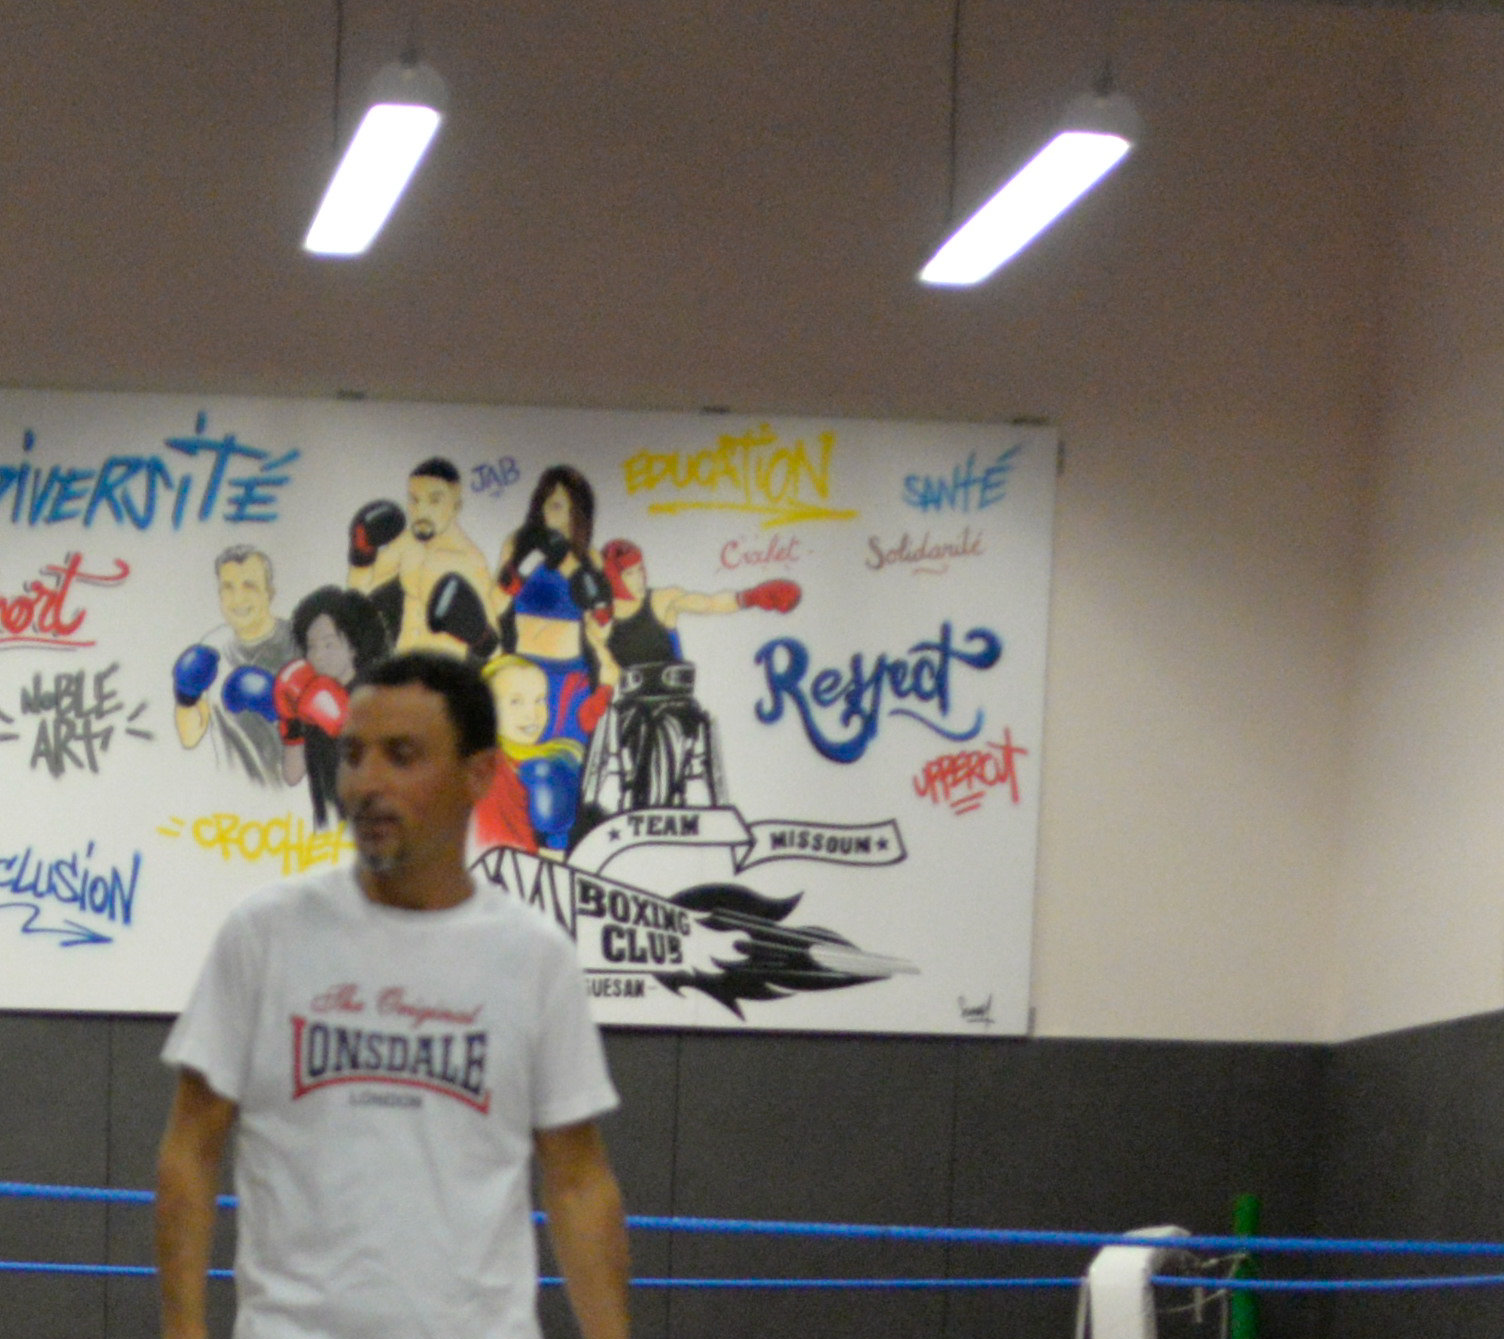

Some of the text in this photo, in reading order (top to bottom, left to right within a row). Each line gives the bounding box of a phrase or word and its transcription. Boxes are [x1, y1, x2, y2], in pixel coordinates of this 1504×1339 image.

[469, 456, 522, 493] JAB
[754, 620, 1004, 763] Respect
[627, 814, 701, 838] TEAM
[577, 876, 692, 938] BOXING
[599, 923, 685, 966] CLUB
[290, 1014, 490, 1115] LONSDALE
